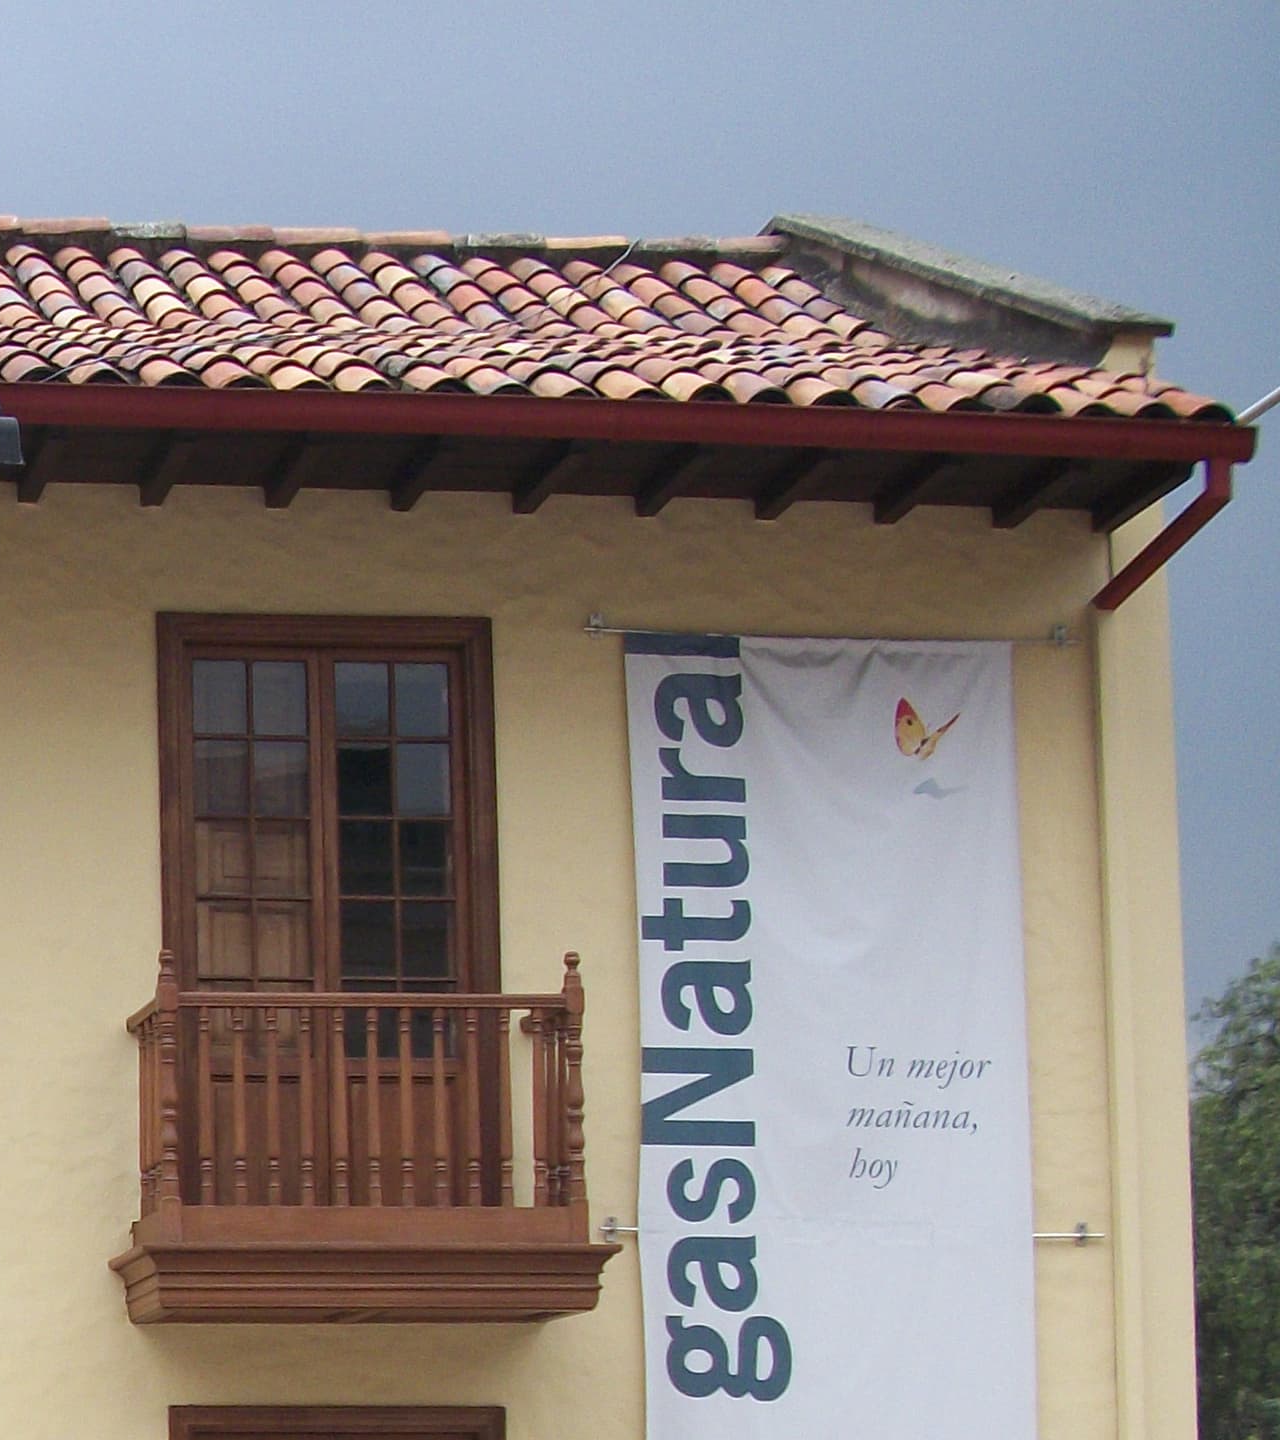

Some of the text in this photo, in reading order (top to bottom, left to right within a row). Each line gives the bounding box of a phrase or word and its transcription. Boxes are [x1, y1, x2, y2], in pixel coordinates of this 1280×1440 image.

[846, 1046, 991, 1089] Un mejor
[846, 1101, 977, 1135] mañana,
[849, 1147, 898, 1189] hoy
